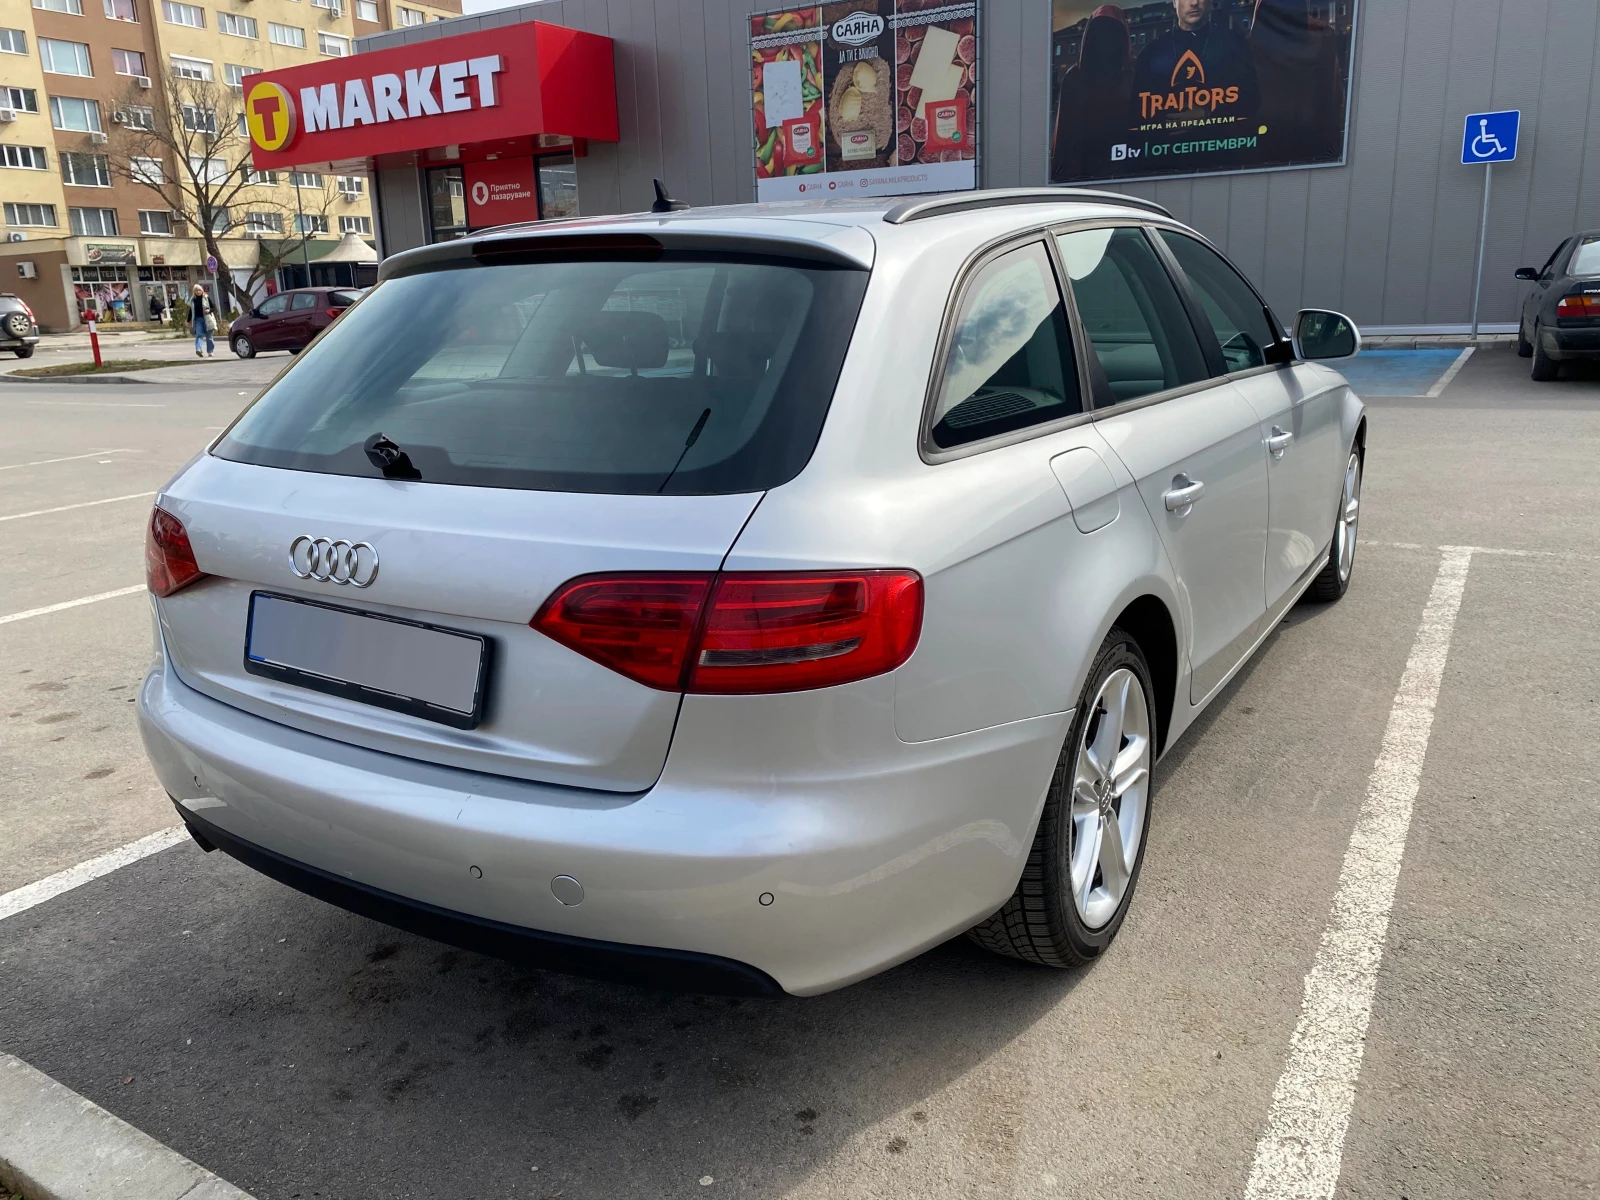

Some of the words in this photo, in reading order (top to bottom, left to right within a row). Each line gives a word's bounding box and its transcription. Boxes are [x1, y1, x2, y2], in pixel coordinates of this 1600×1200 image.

[836, 19, 880, 37] САЯНА
[253, 96, 280, 142] T
[300, 54, 501, 133] MARKET
[1138, 86, 1239, 118] TRAITORS
[1140, 123, 1163, 131] ИГРА
[1165, 121, 1178, 129] НА
[1181, 116, 1236, 127] ПРЕДАТЕЛИ
[1151, 143, 1171, 156] ОТ
[1172, 136, 1257, 154] СЕПТЕМВРИ
[490, 182, 521, 192] Приятно
[491, 190, 531, 201] пазаруване
